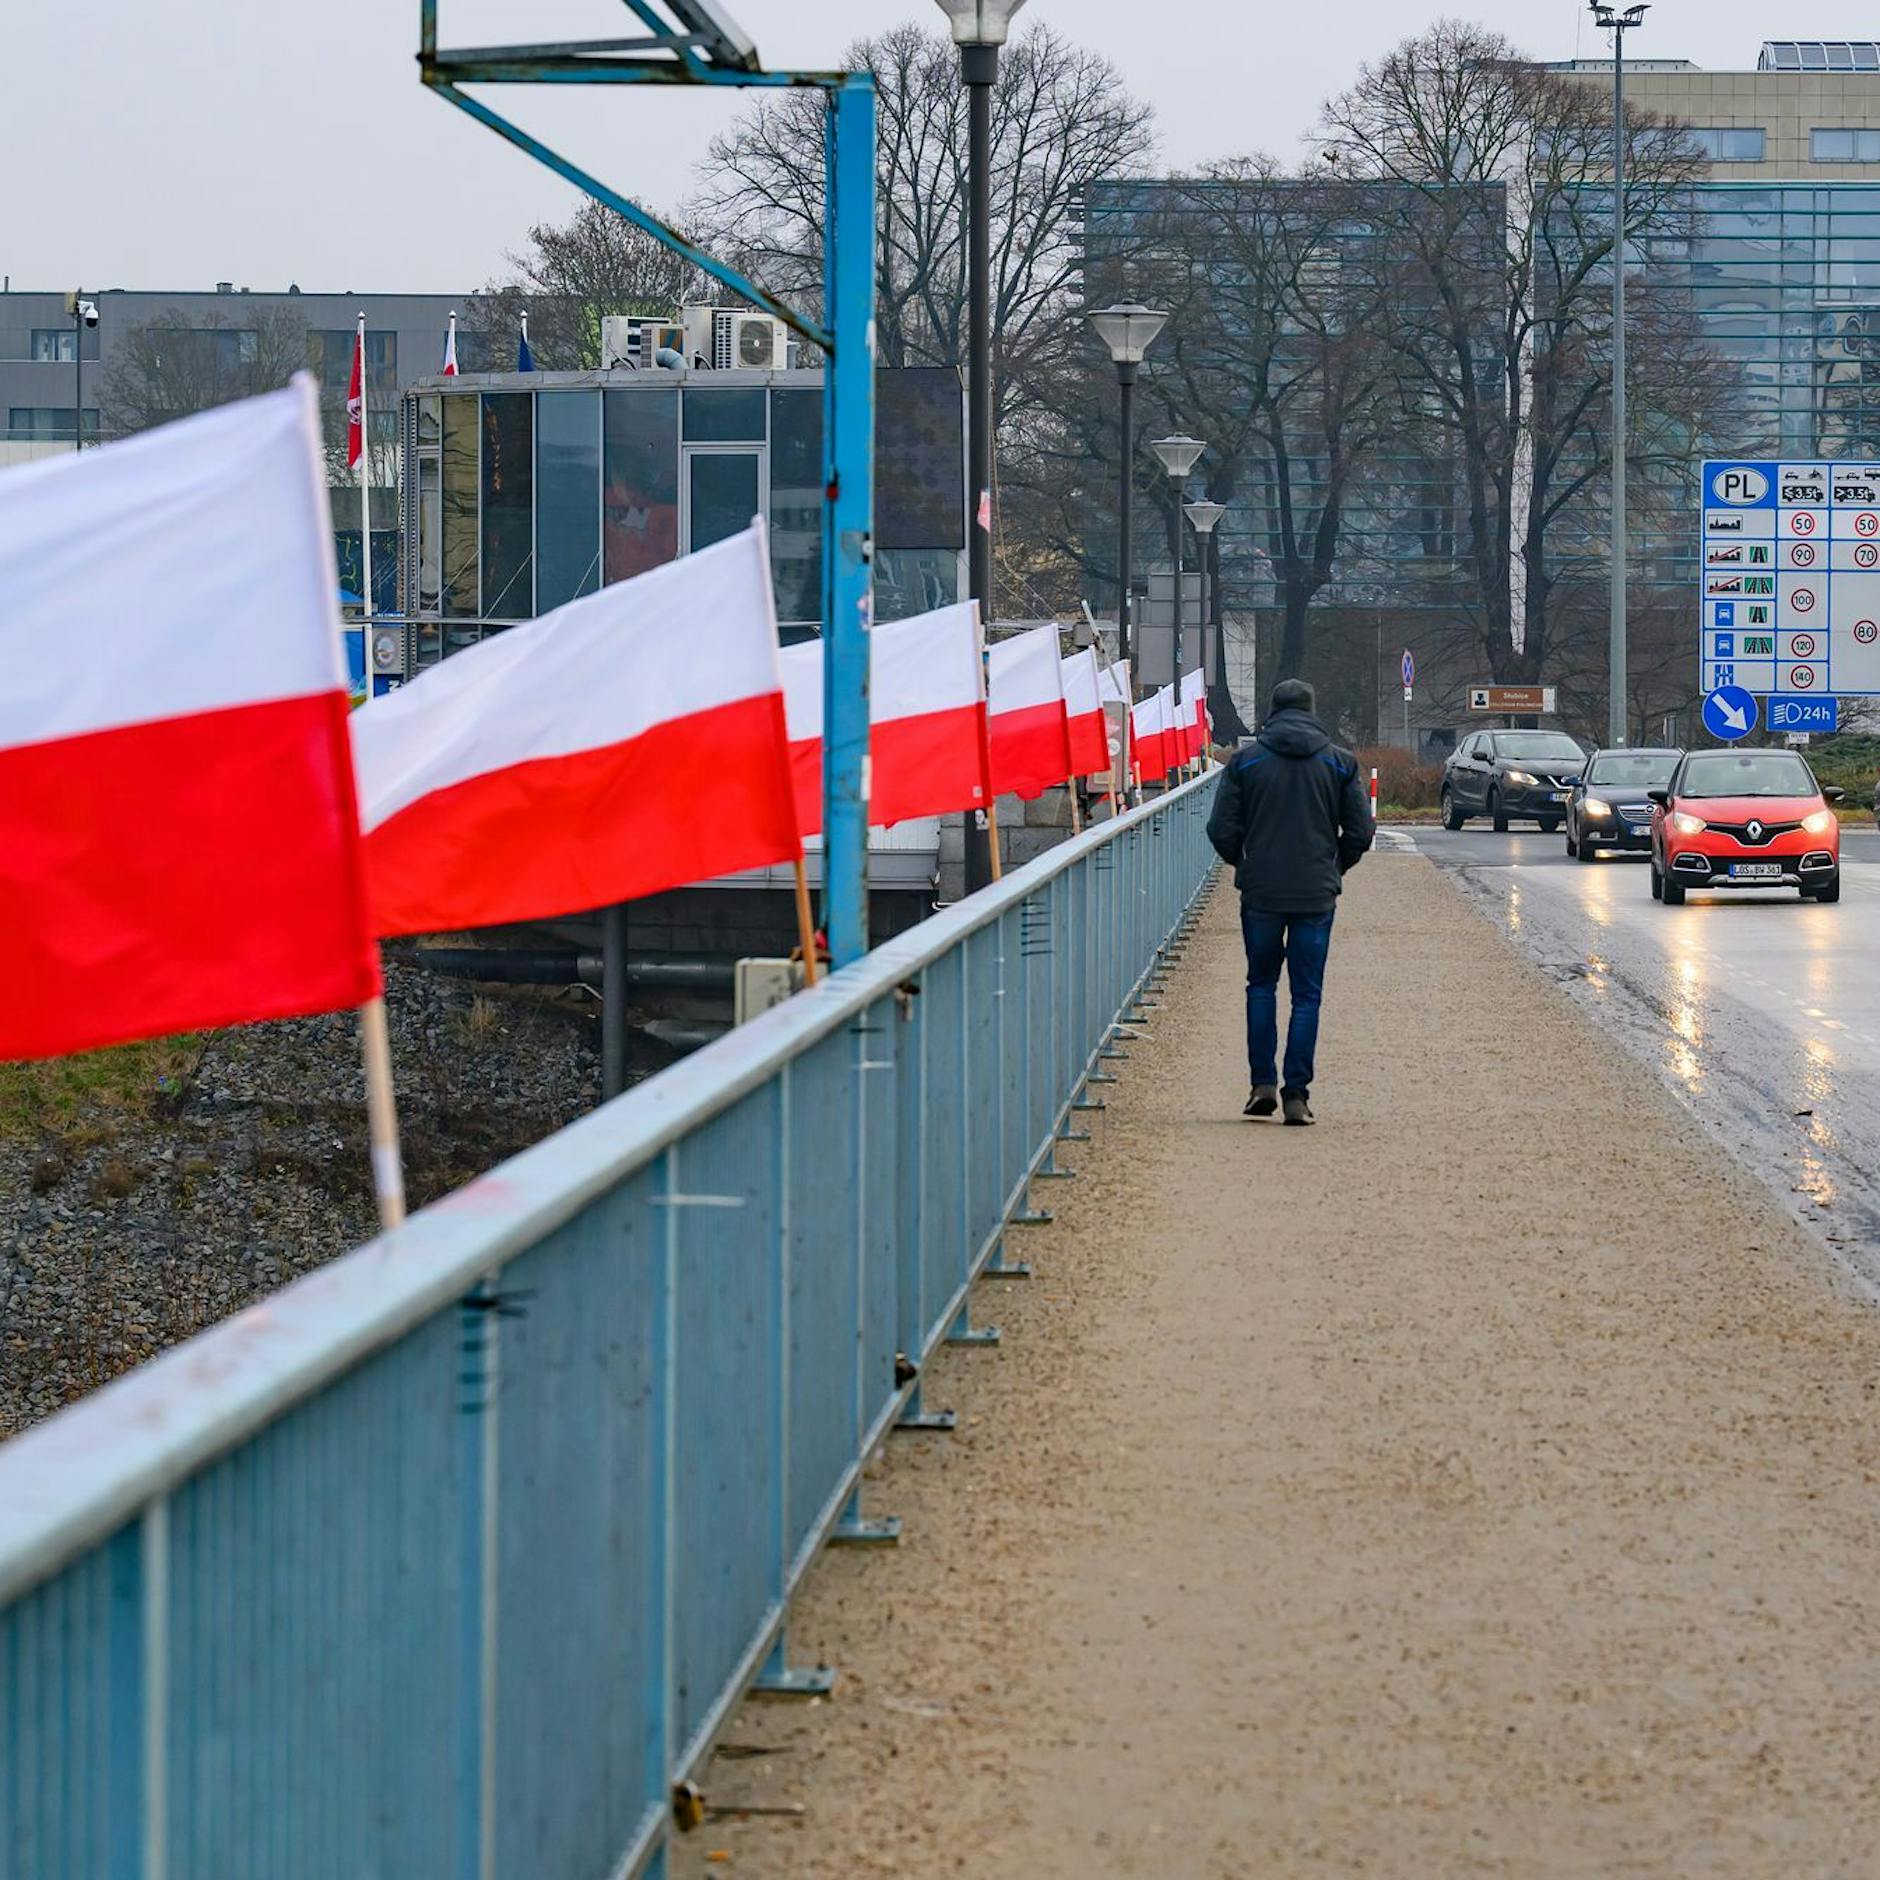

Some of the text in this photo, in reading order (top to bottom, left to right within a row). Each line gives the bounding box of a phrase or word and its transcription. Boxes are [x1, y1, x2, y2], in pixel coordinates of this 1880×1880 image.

[1724, 473, 1756, 499] PL
[1795, 517, 1812, 530] 50
[1858, 518, 1875, 531] 50
[1795, 548, 1812, 561] 90
[1859, 549, 1876, 562] 70
[1794, 595, 1812, 605] 100
[1857, 626, 1875, 638] 80
[1795, 641, 1812, 651] 120
[1794, 672, 1812, 682] 140
[1802, 706, 1831, 720] 24h
